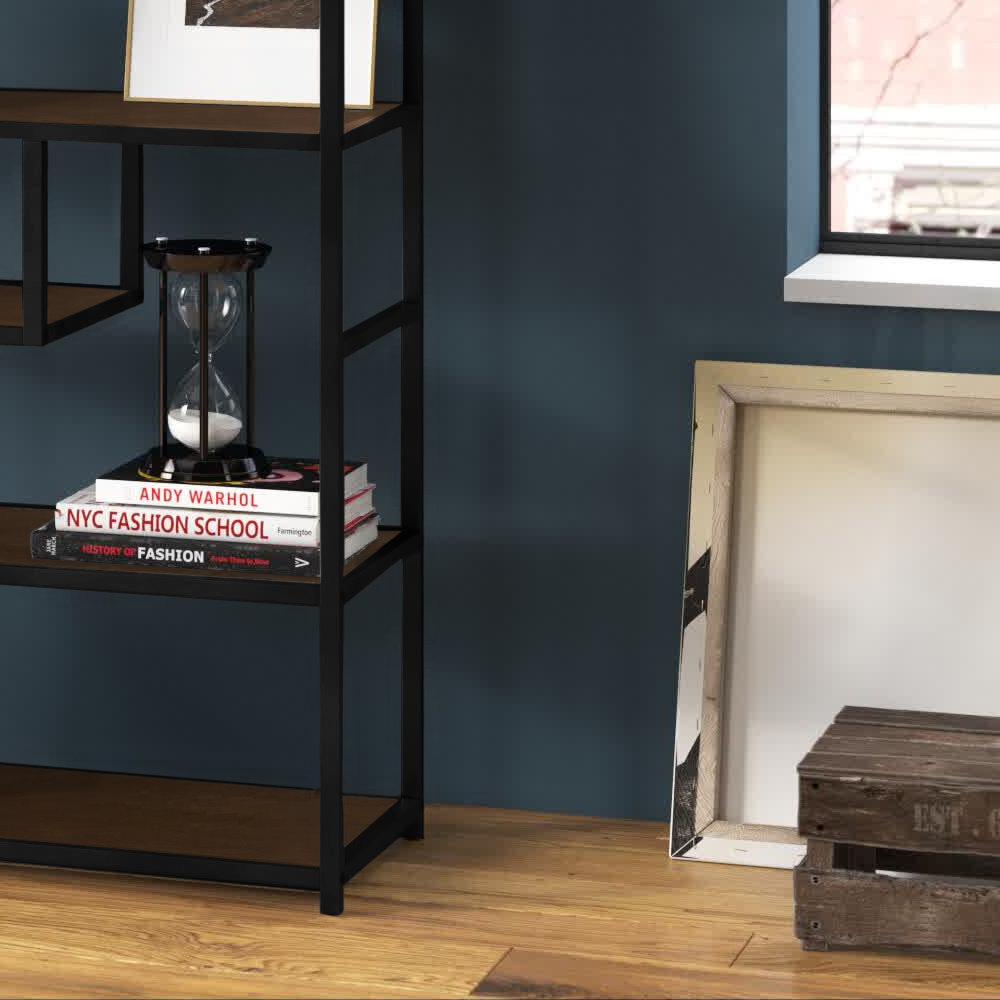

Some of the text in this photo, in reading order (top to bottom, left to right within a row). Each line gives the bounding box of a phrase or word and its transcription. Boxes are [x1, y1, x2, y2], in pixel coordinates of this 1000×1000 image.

[139, 486, 259, 508] ANDY WARHOL
[67, 508, 104, 530] NYC
[108, 511, 189, 535] FASHION
[194, 516, 269, 540] SCHOOL
[81, 544, 122, 556] HISTORY
[123, 547, 137, 557] OF
[138, 547, 205, 563] FASHION
